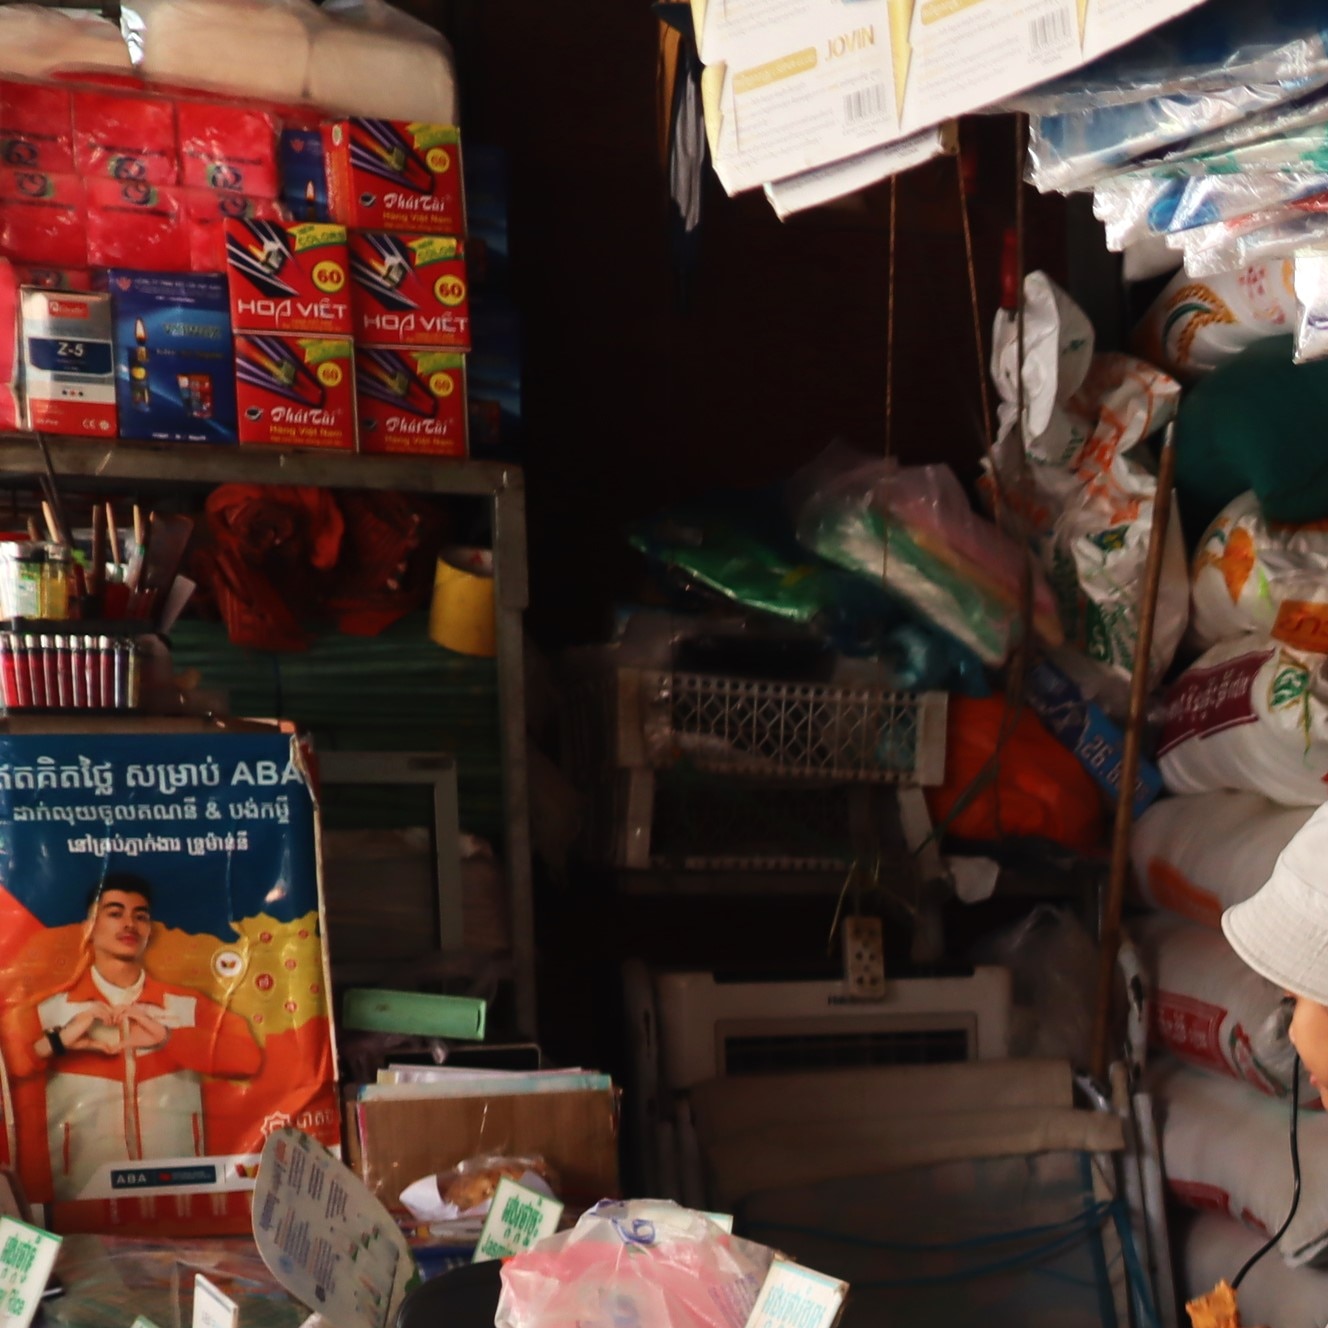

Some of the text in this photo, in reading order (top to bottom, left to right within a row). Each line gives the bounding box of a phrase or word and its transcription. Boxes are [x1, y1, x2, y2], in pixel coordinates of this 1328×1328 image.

[825, 25, 875, 62] JOVIN
[317, 267, 343, 284] 60
[439, 283, 464, 299] 60
[230, 761, 304, 787] ABA
[116, 1172, 147, 1186] ABA
